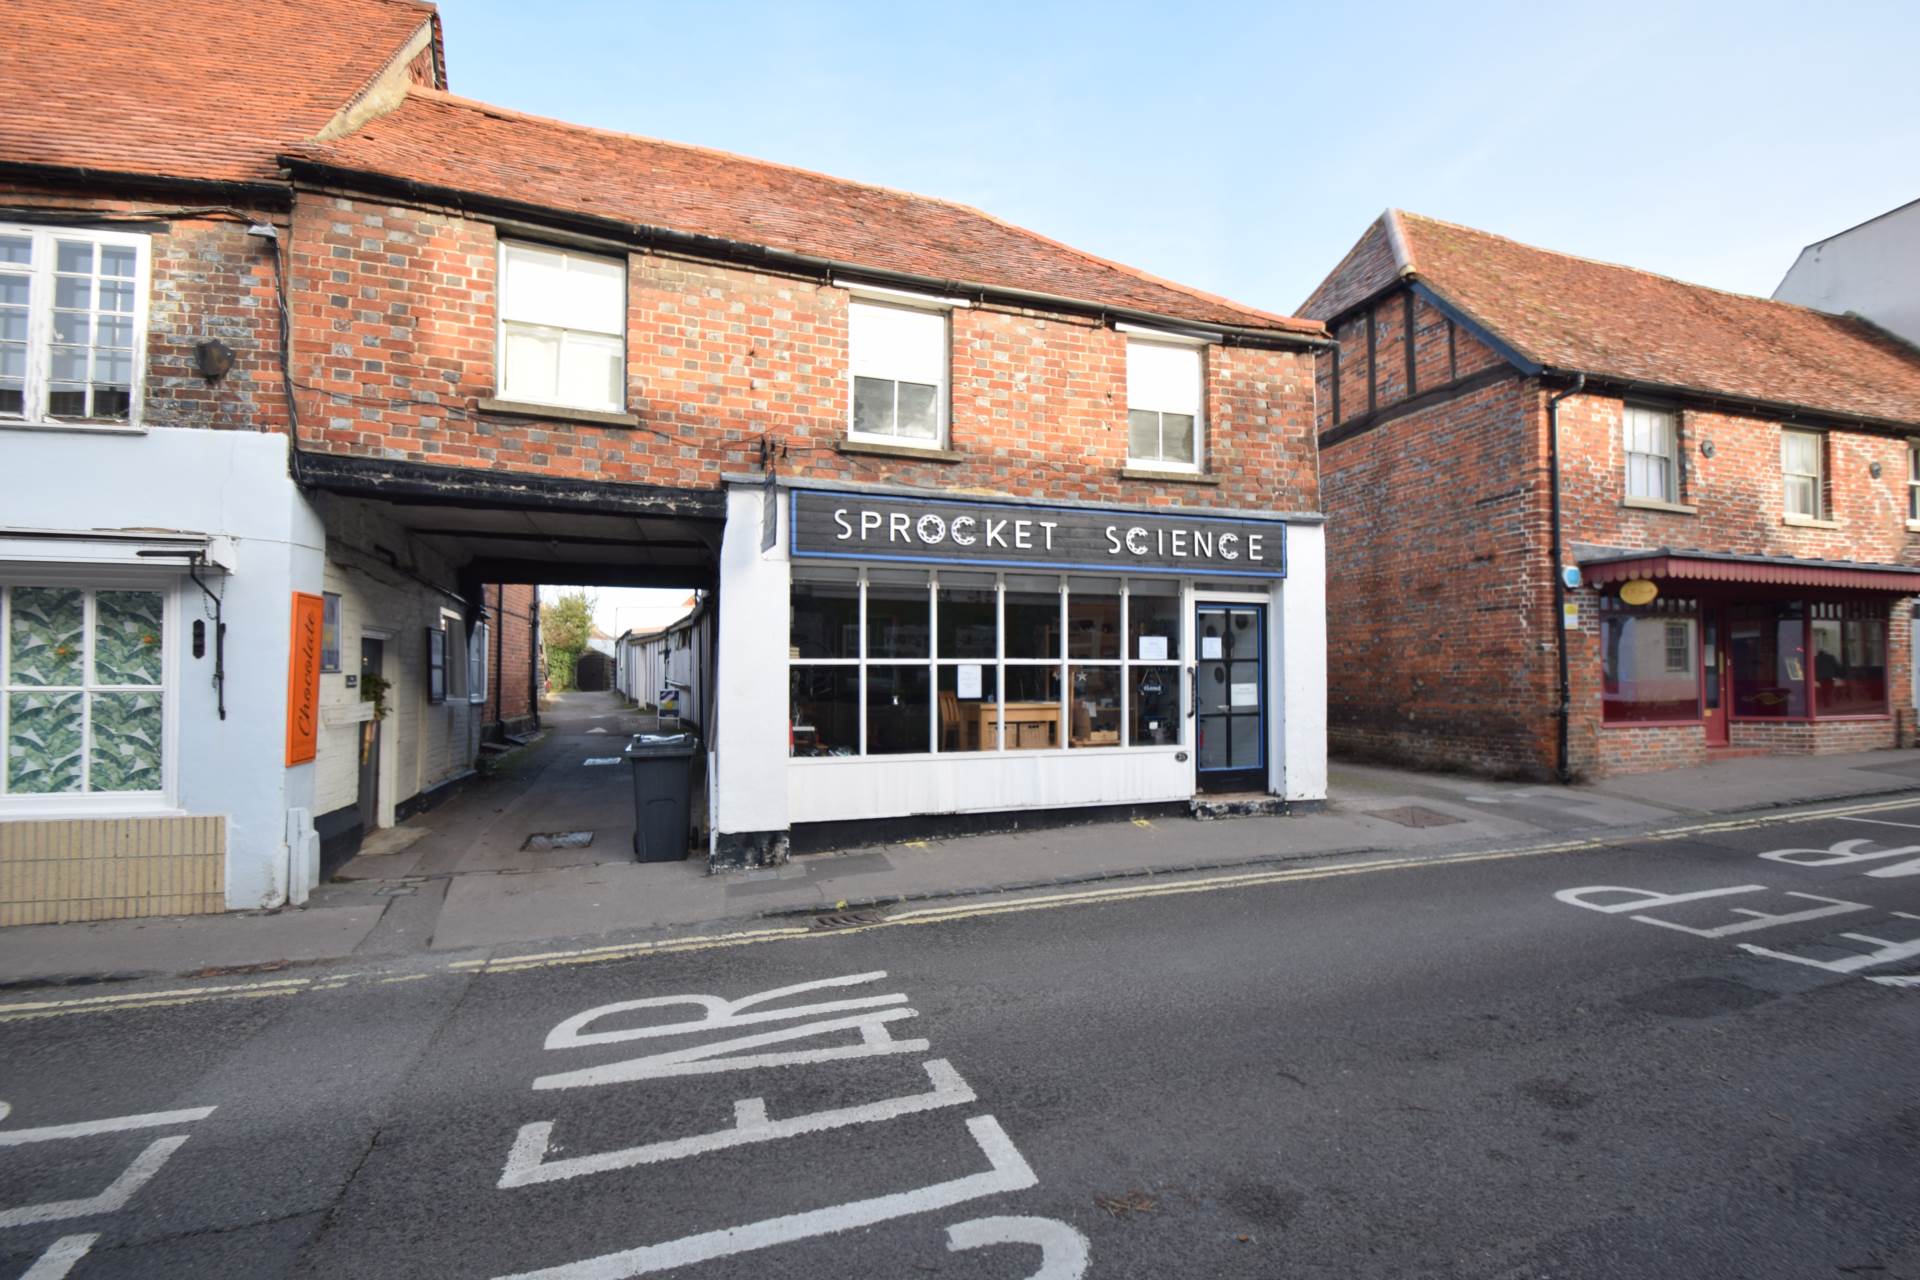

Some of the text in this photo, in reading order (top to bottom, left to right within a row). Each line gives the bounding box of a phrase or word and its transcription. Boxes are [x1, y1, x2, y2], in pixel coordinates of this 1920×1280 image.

[834, 509, 1264, 560] SPROCKET SCIENCE
[298, 612, 316, 737] Chocolate
[490, 970, 1091, 1280] LEAR
